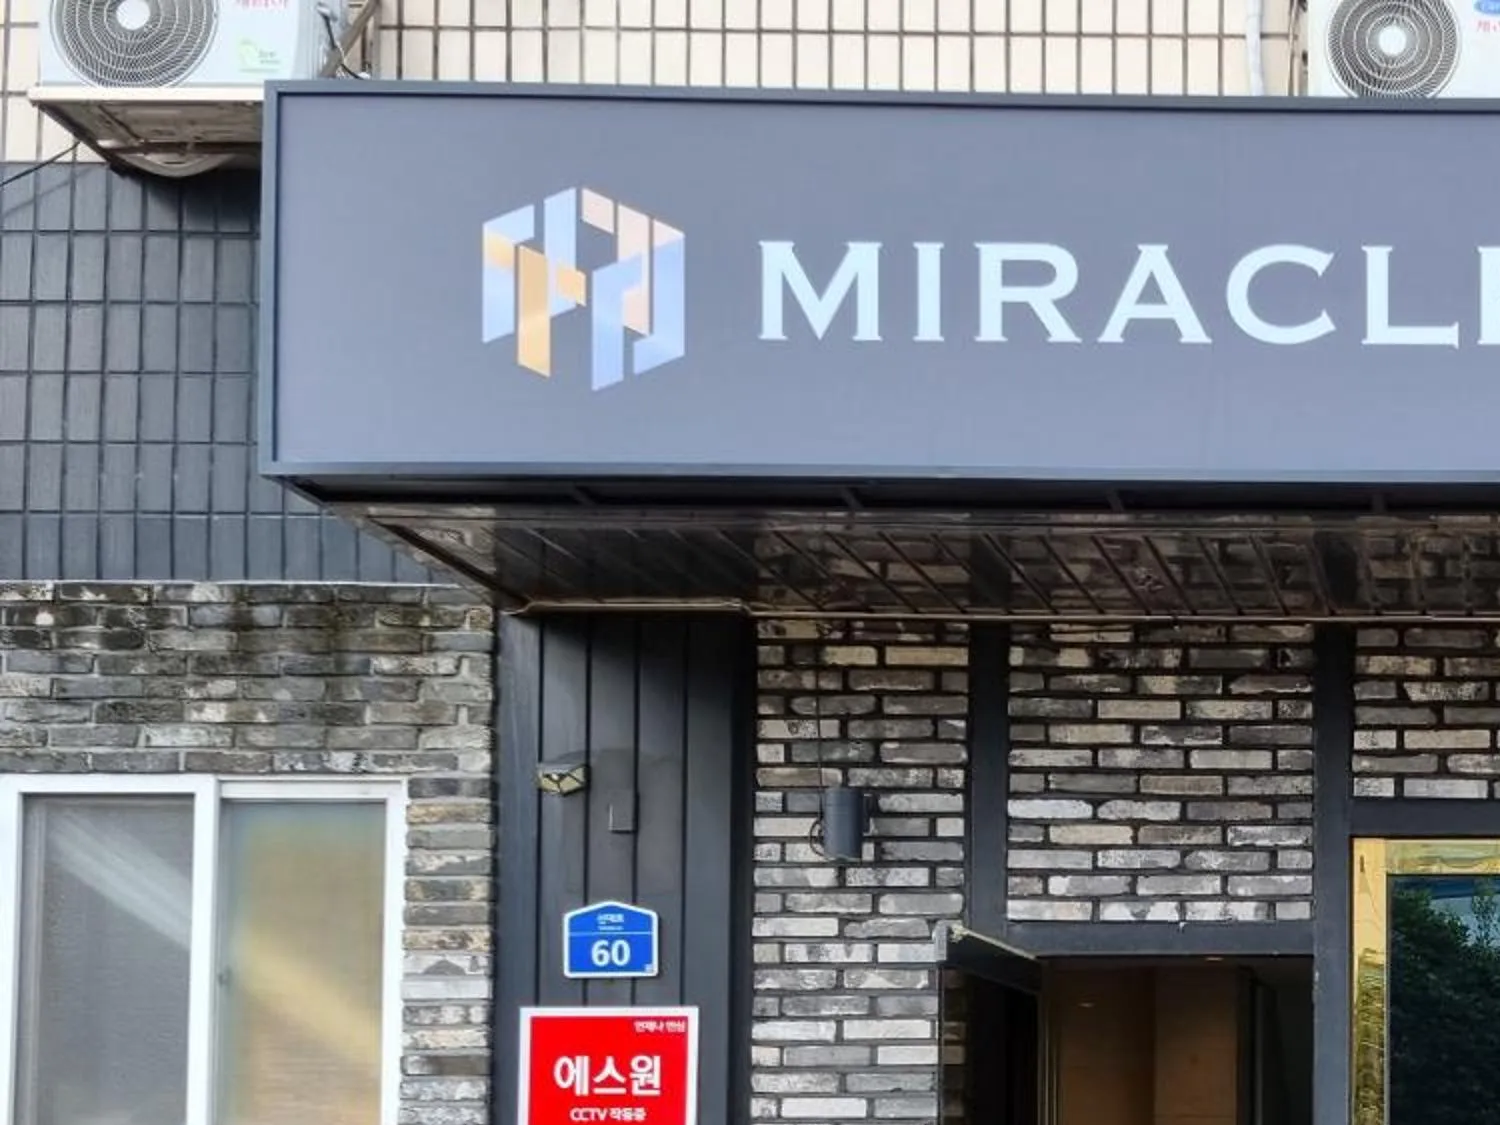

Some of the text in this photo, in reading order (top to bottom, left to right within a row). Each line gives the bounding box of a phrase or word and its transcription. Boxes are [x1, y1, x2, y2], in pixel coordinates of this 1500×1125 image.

[592, 939, 631, 967] 60
[554, 1055, 661, 1096] 에스원
[570, 1107, 645, 1121] CCTV 작동중
